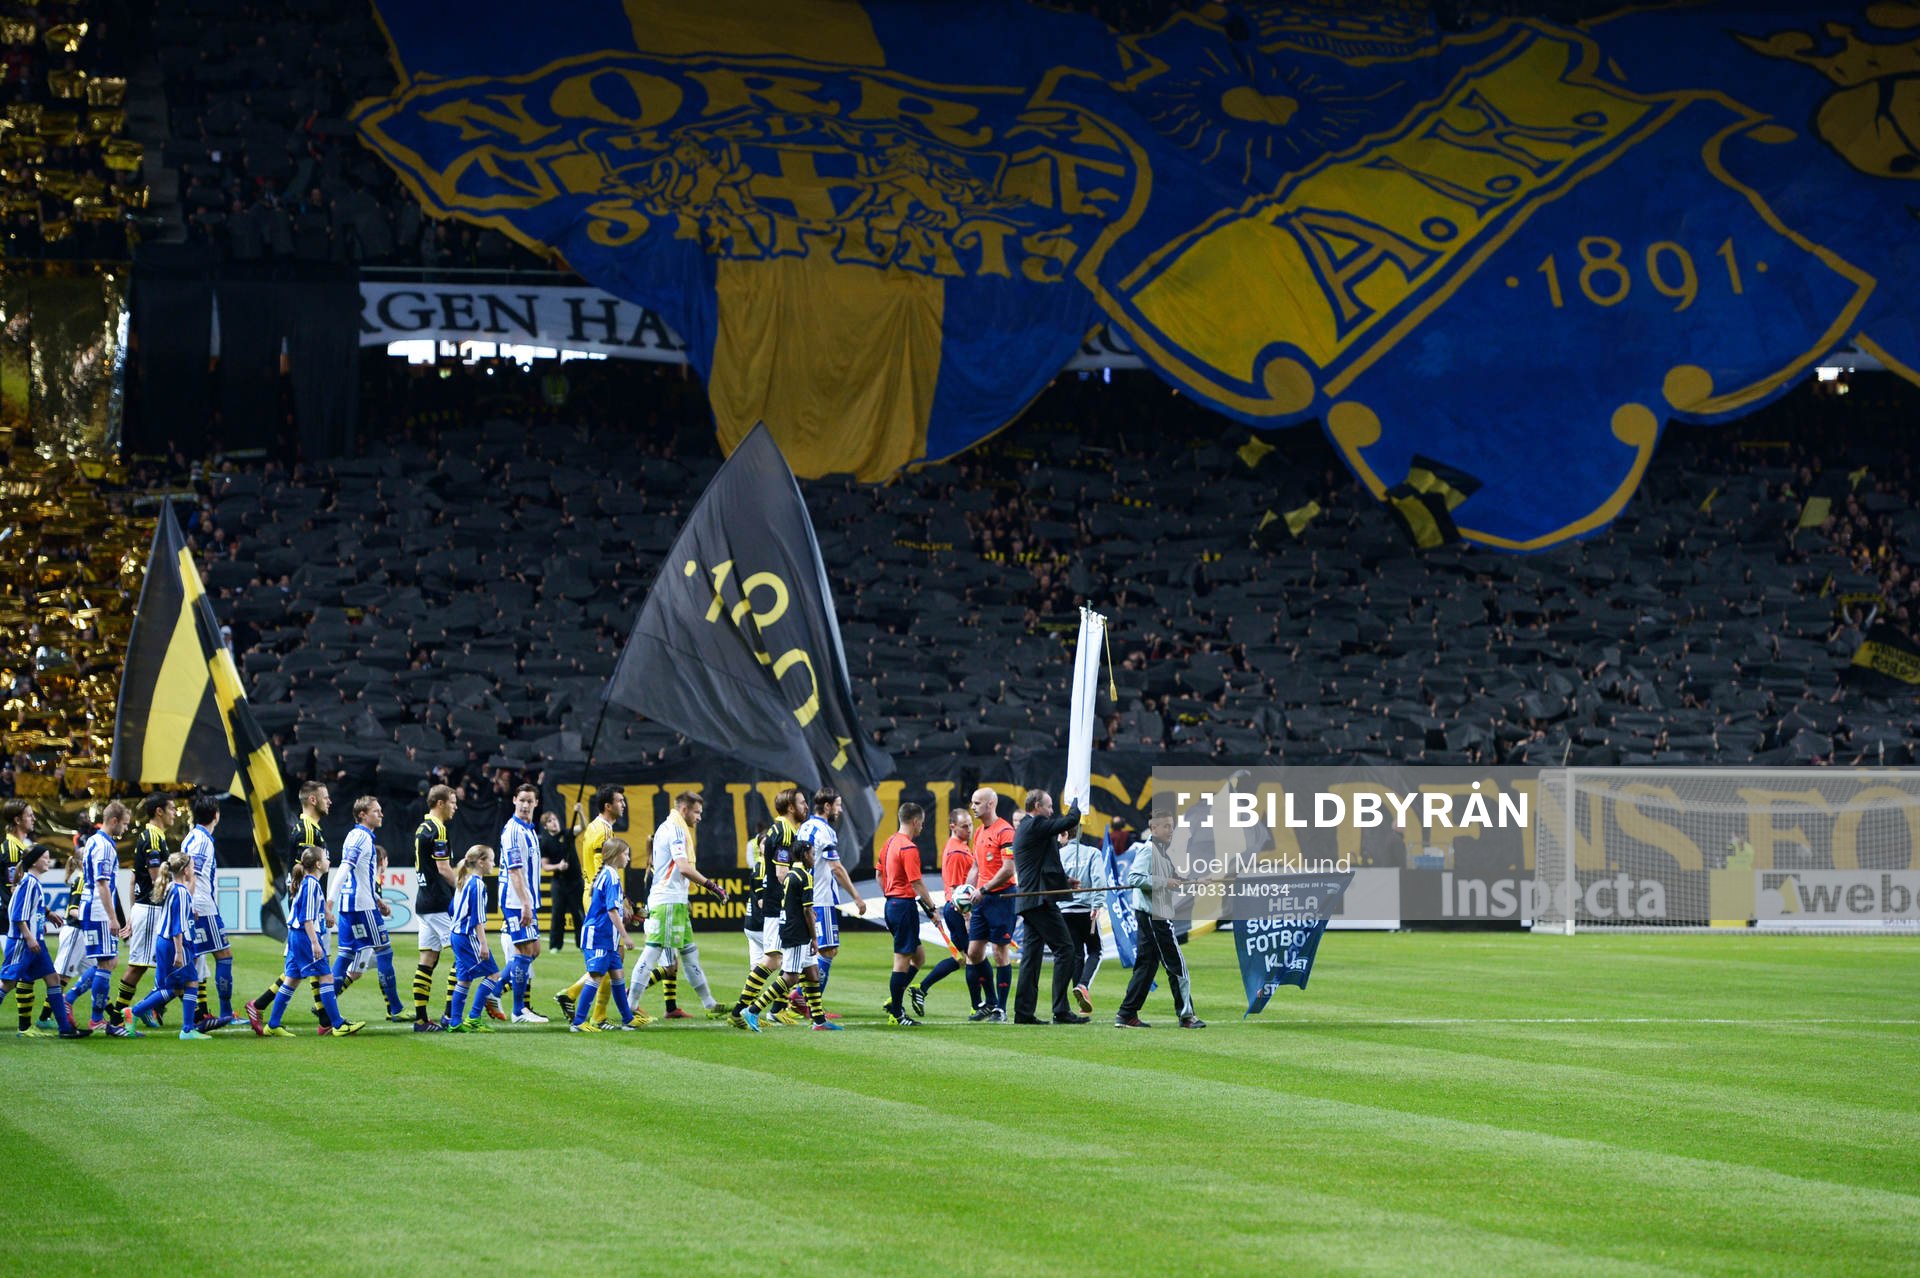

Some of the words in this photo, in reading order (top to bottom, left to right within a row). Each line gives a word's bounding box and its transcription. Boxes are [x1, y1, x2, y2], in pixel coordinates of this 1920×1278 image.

[1268, 895, 1319, 913] HELA
[1440, 871, 1668, 928] Inspecta
[1799, 872, 1920, 915] web
[1245, 929, 1310, 956] FOTBO
